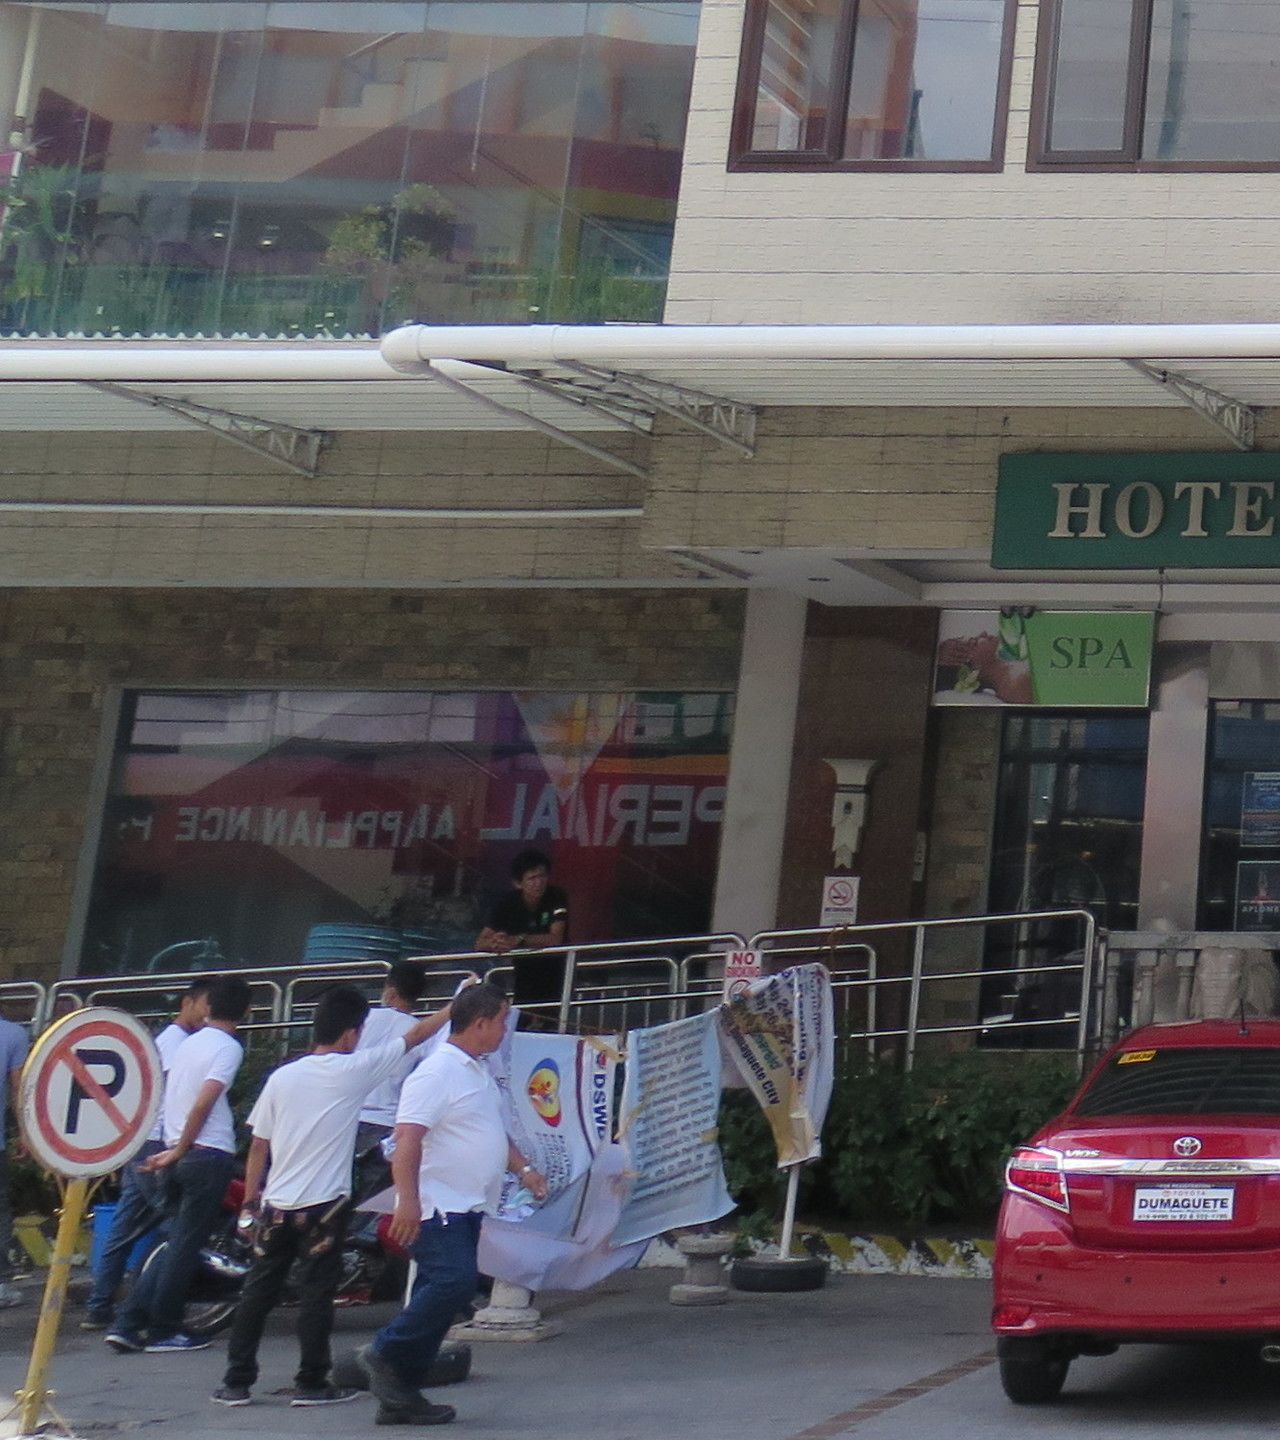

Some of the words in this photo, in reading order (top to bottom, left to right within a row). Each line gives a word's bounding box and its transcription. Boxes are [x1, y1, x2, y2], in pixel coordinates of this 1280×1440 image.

[1049, 635, 1133, 670] SPA
[732, 952, 755, 965] NO
[1138, 1198, 1230, 1209] DUMAGUETE
